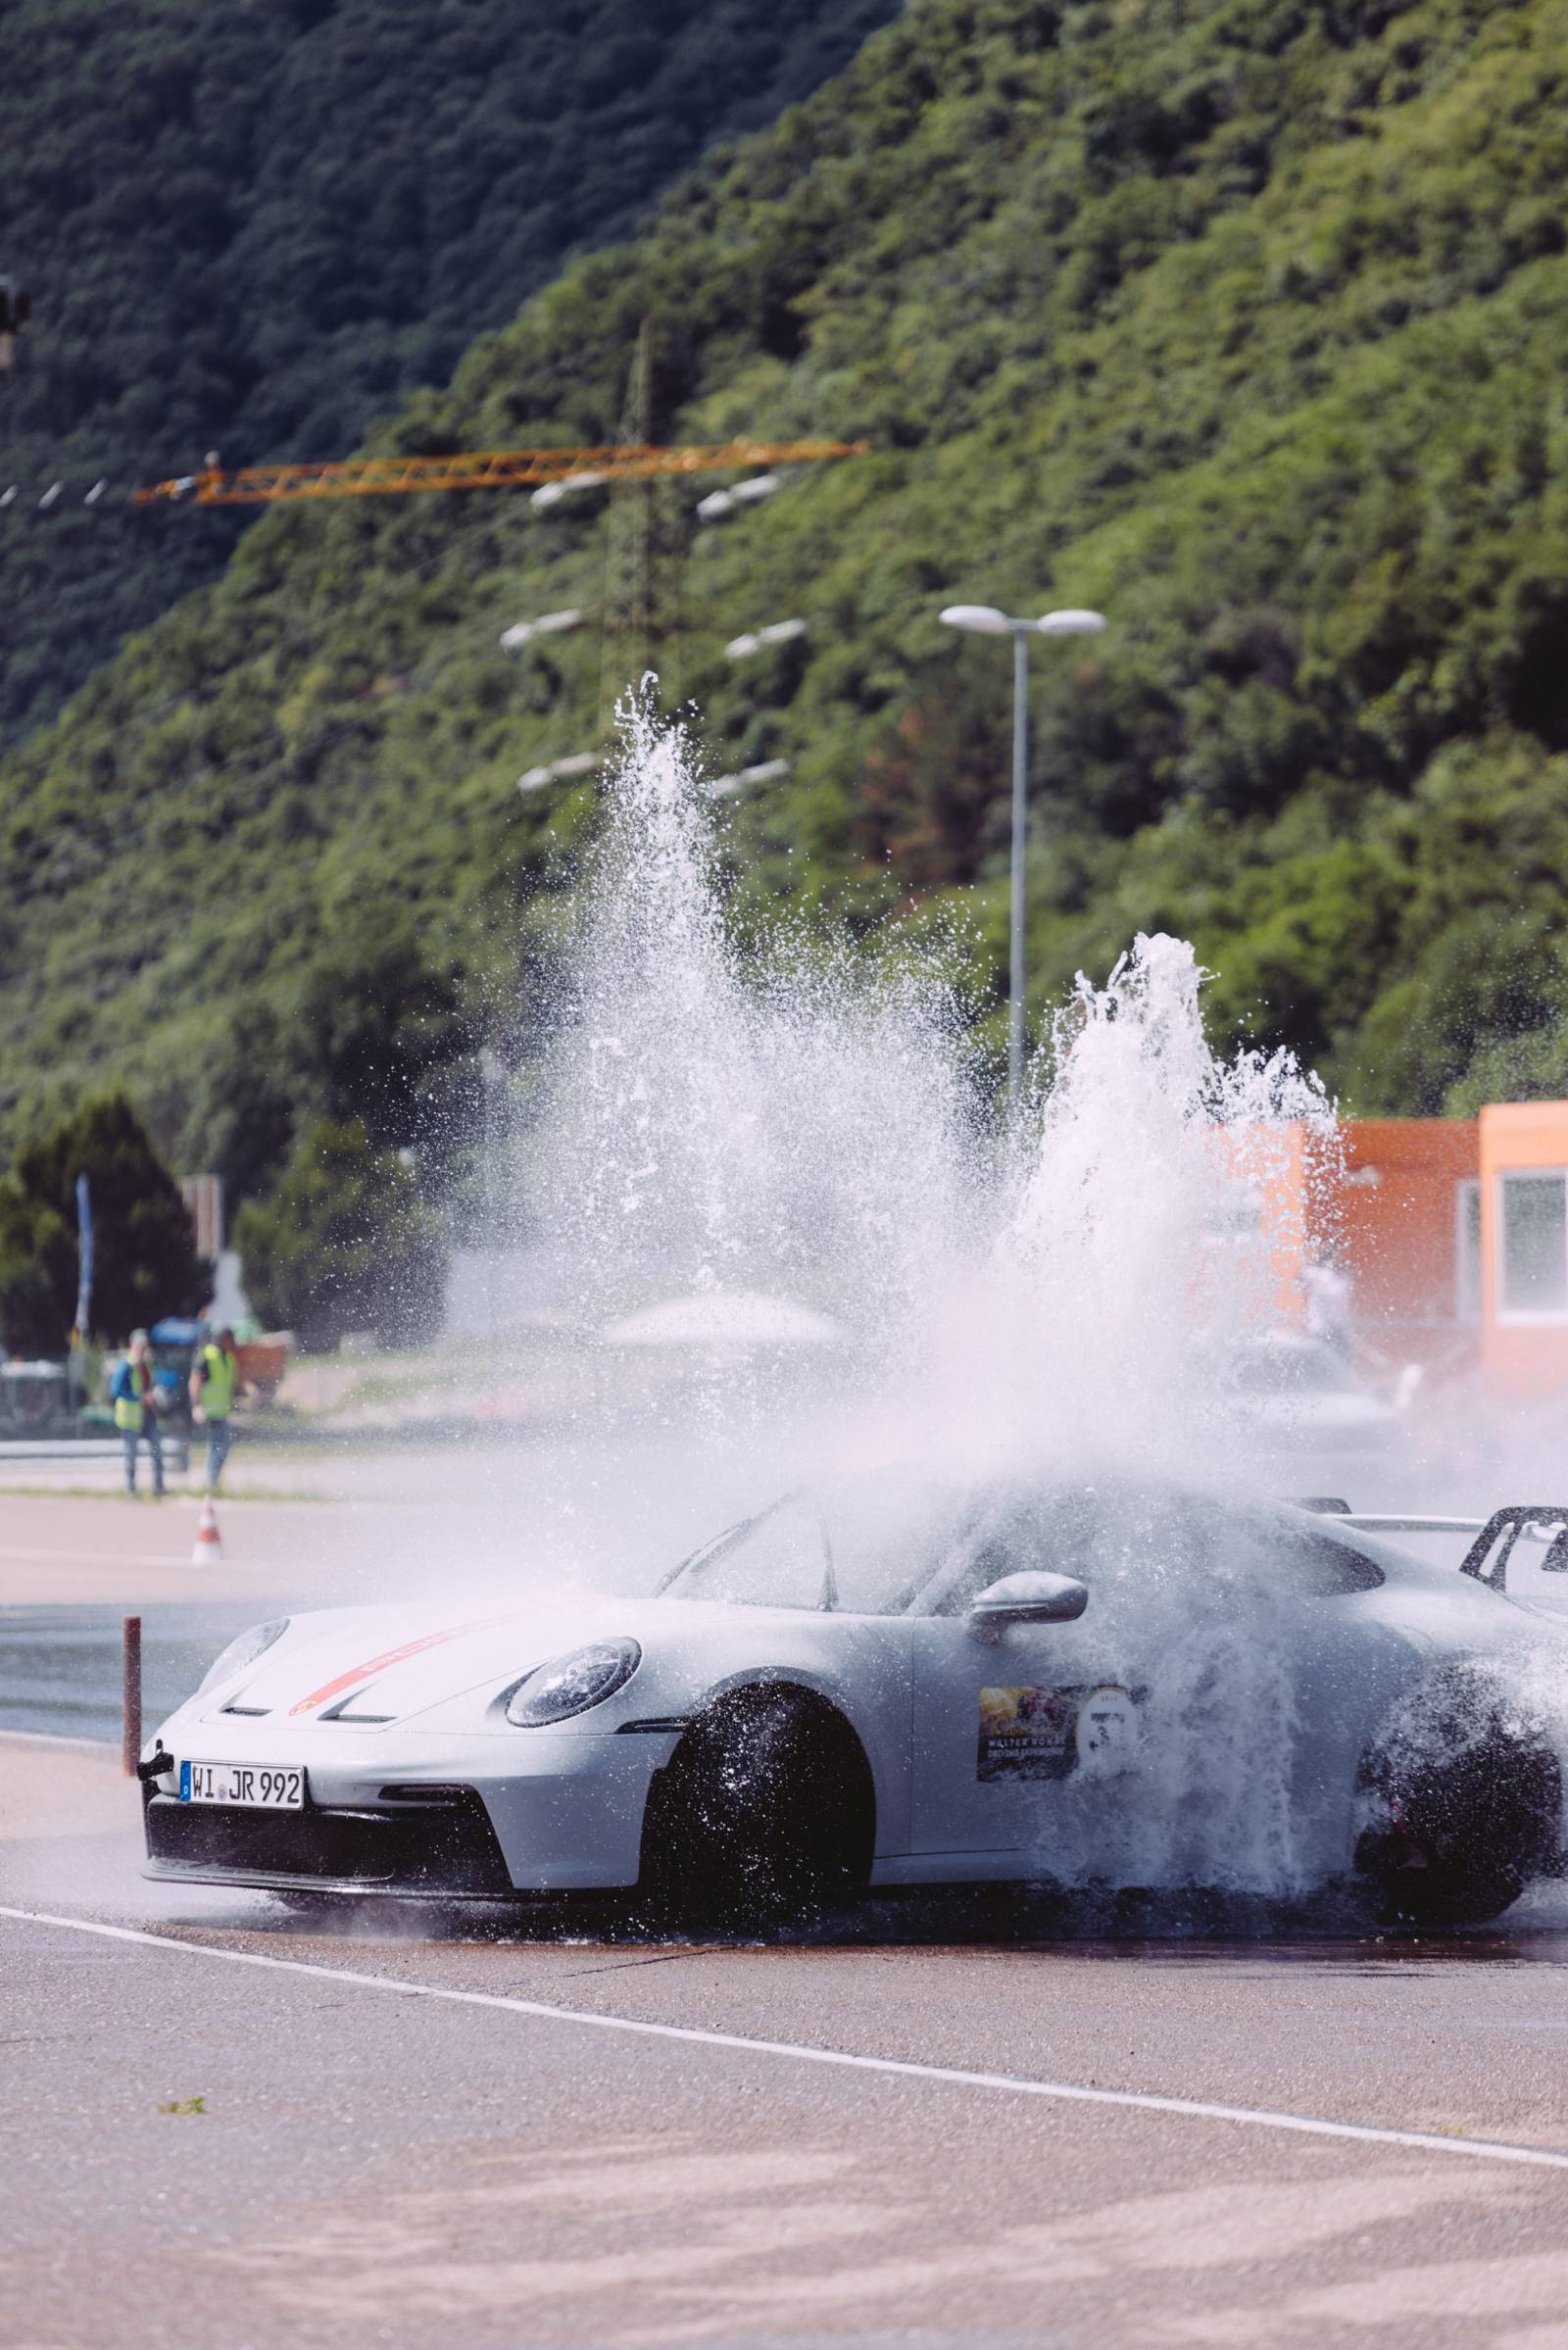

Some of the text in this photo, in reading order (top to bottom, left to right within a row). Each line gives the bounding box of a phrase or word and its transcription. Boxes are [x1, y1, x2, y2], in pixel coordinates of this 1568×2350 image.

[988, 1738, 1029, 1747] WALTER
[988, 1748, 1019, 1757] DRIVING
[192, 1765, 300, 1803] WI JR 992
